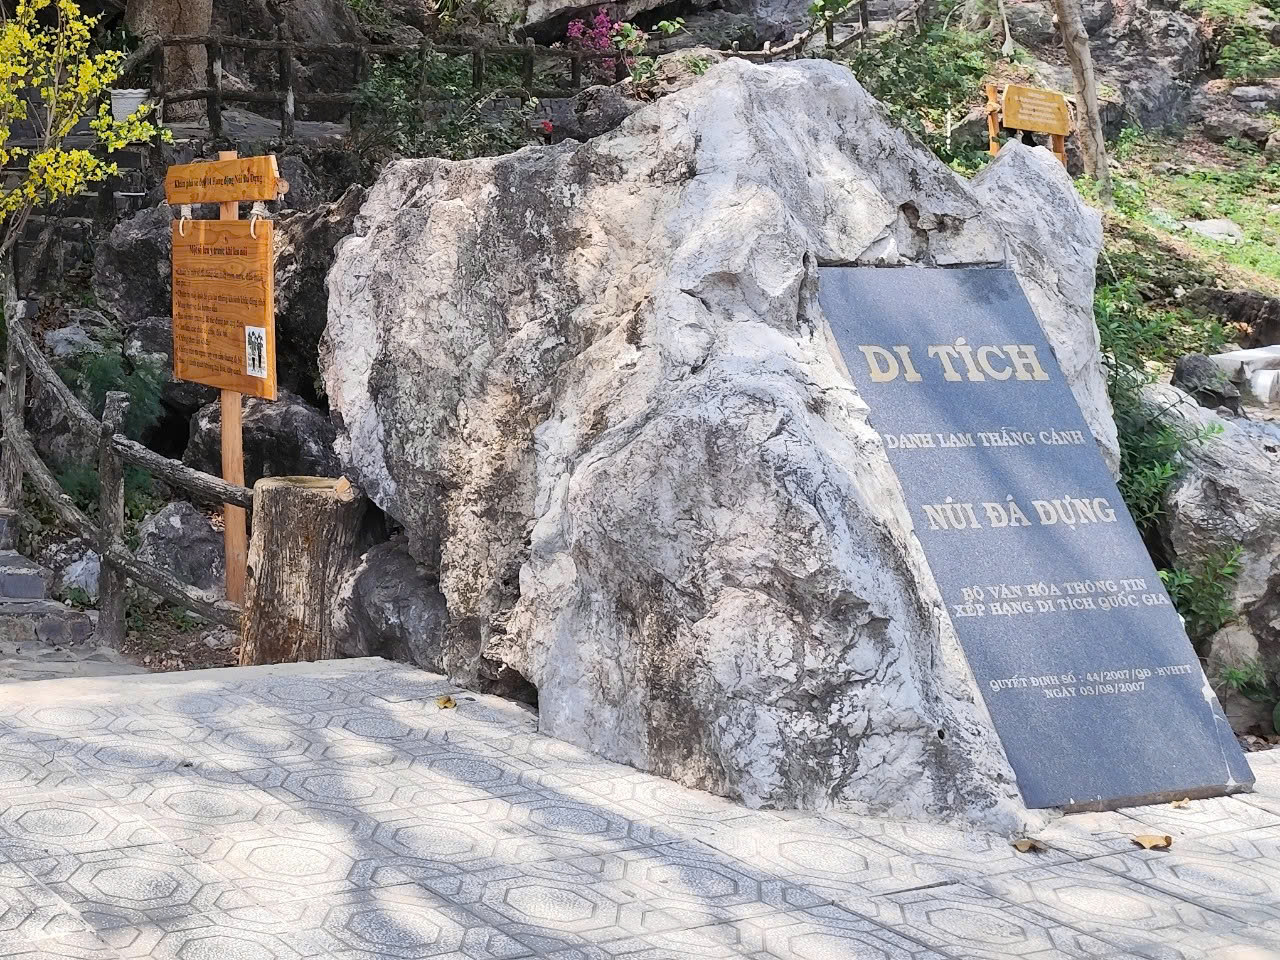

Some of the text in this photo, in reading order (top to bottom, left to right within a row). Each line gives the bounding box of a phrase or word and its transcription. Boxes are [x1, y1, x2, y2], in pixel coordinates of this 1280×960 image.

[858, 337, 1050, 383] DI TÍCH
[884, 433, 936, 449] DANH
[936, 433, 976, 447] LAM
[977, 426, 1036, 446] THẮNG
[922, 494, 1117, 530] NÚI ĐÁ DỰNG
[961, 584, 984, 602] BỘ
[1063, 579, 1118, 595] THÔNG
[1120, 578, 1147, 591] TIN
[953, 591, 1170, 617] XẾP HẠNG DI TÍCH QUỐC GIA
[990, 674, 1028, 692] QUYẾT
[1030, 675, 1060, 688] ĐỊNH
[1061, 670, 1076, 684] SỐ
[1044, 681, 1145, 699] NGÀY 03/08/2007
